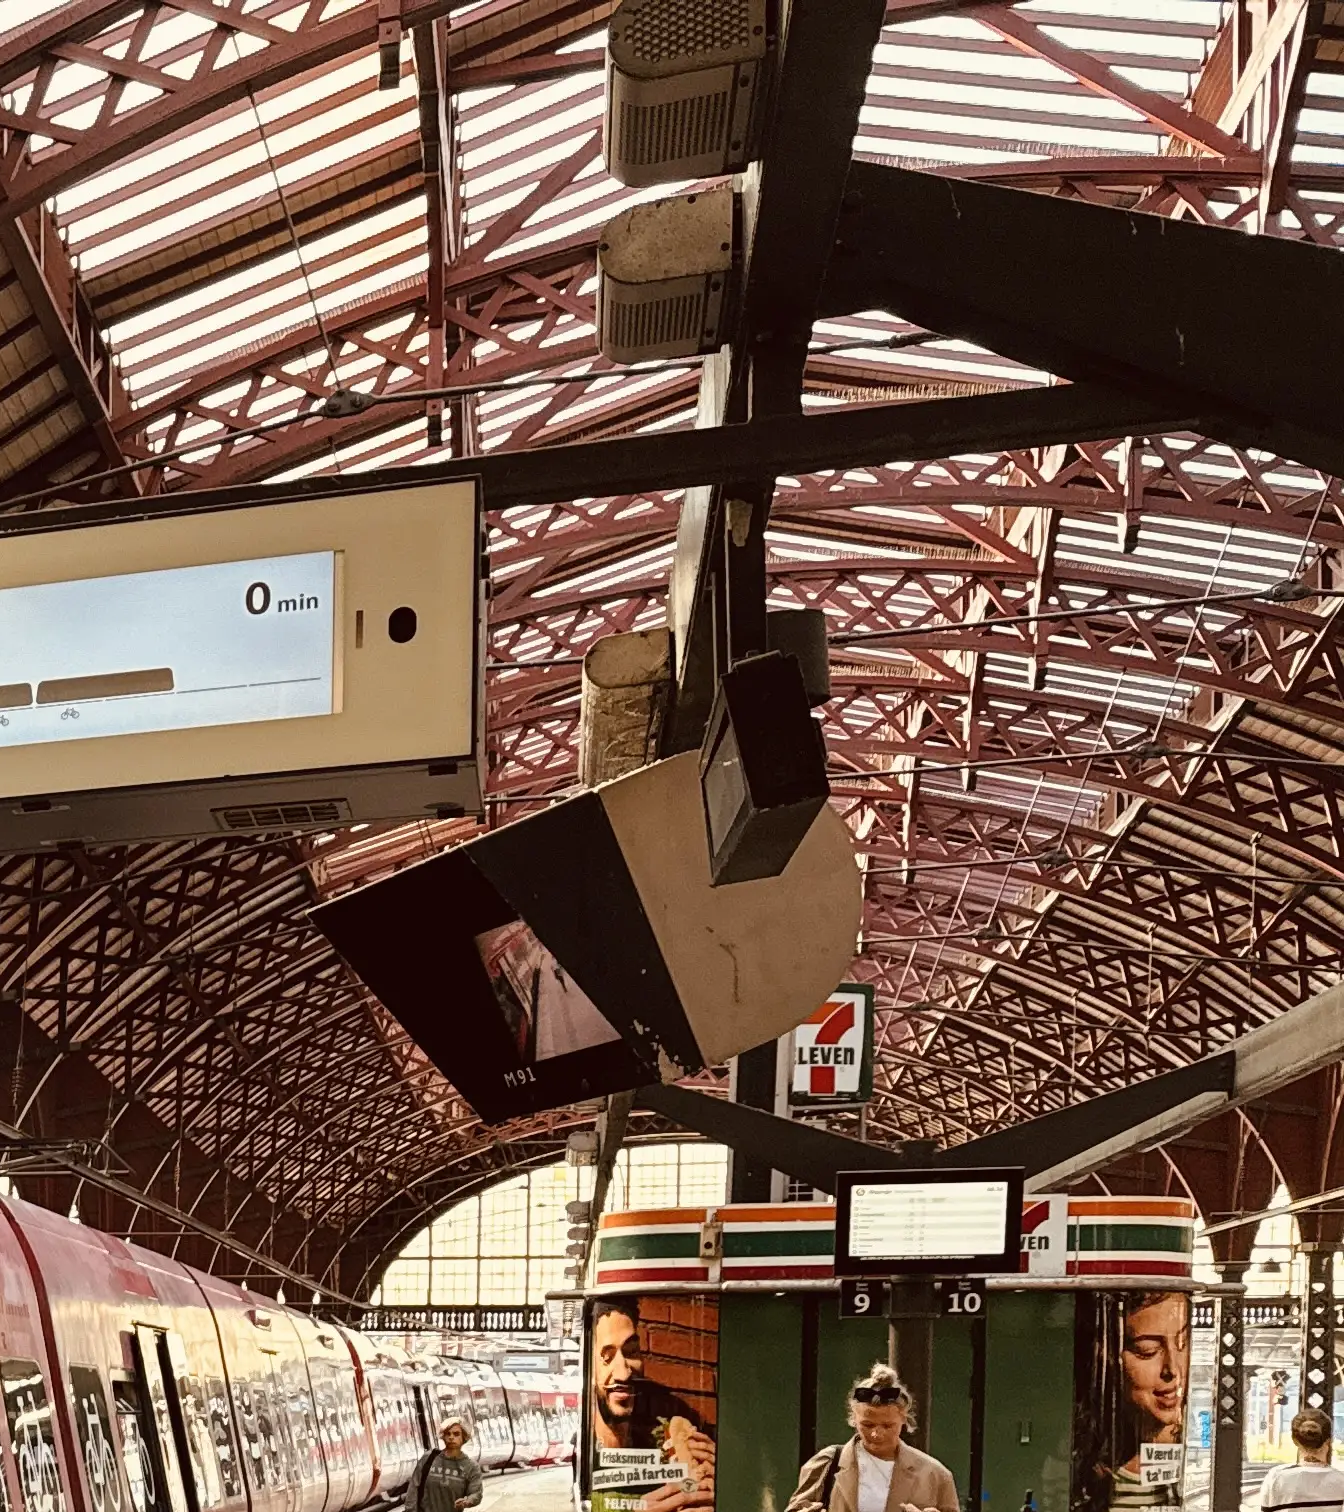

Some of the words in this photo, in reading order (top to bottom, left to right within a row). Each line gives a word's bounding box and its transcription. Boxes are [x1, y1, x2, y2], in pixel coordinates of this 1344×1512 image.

[245, 581, 271, 615] 0
[277, 593, 319, 612] min
[795, 1046, 855, 1065] LEVEn
[503, 1066, 537, 1089] M91
[853, 1293, 870, 1314] 9
[947, 1292, 982, 1313] 10
[601, 1451, 656, 1465] Frisksmurt
[1145, 1447, 1173, 1461] Værd
[626, 1468, 641, 1484] på
[642, 1467, 684, 1482] farten
